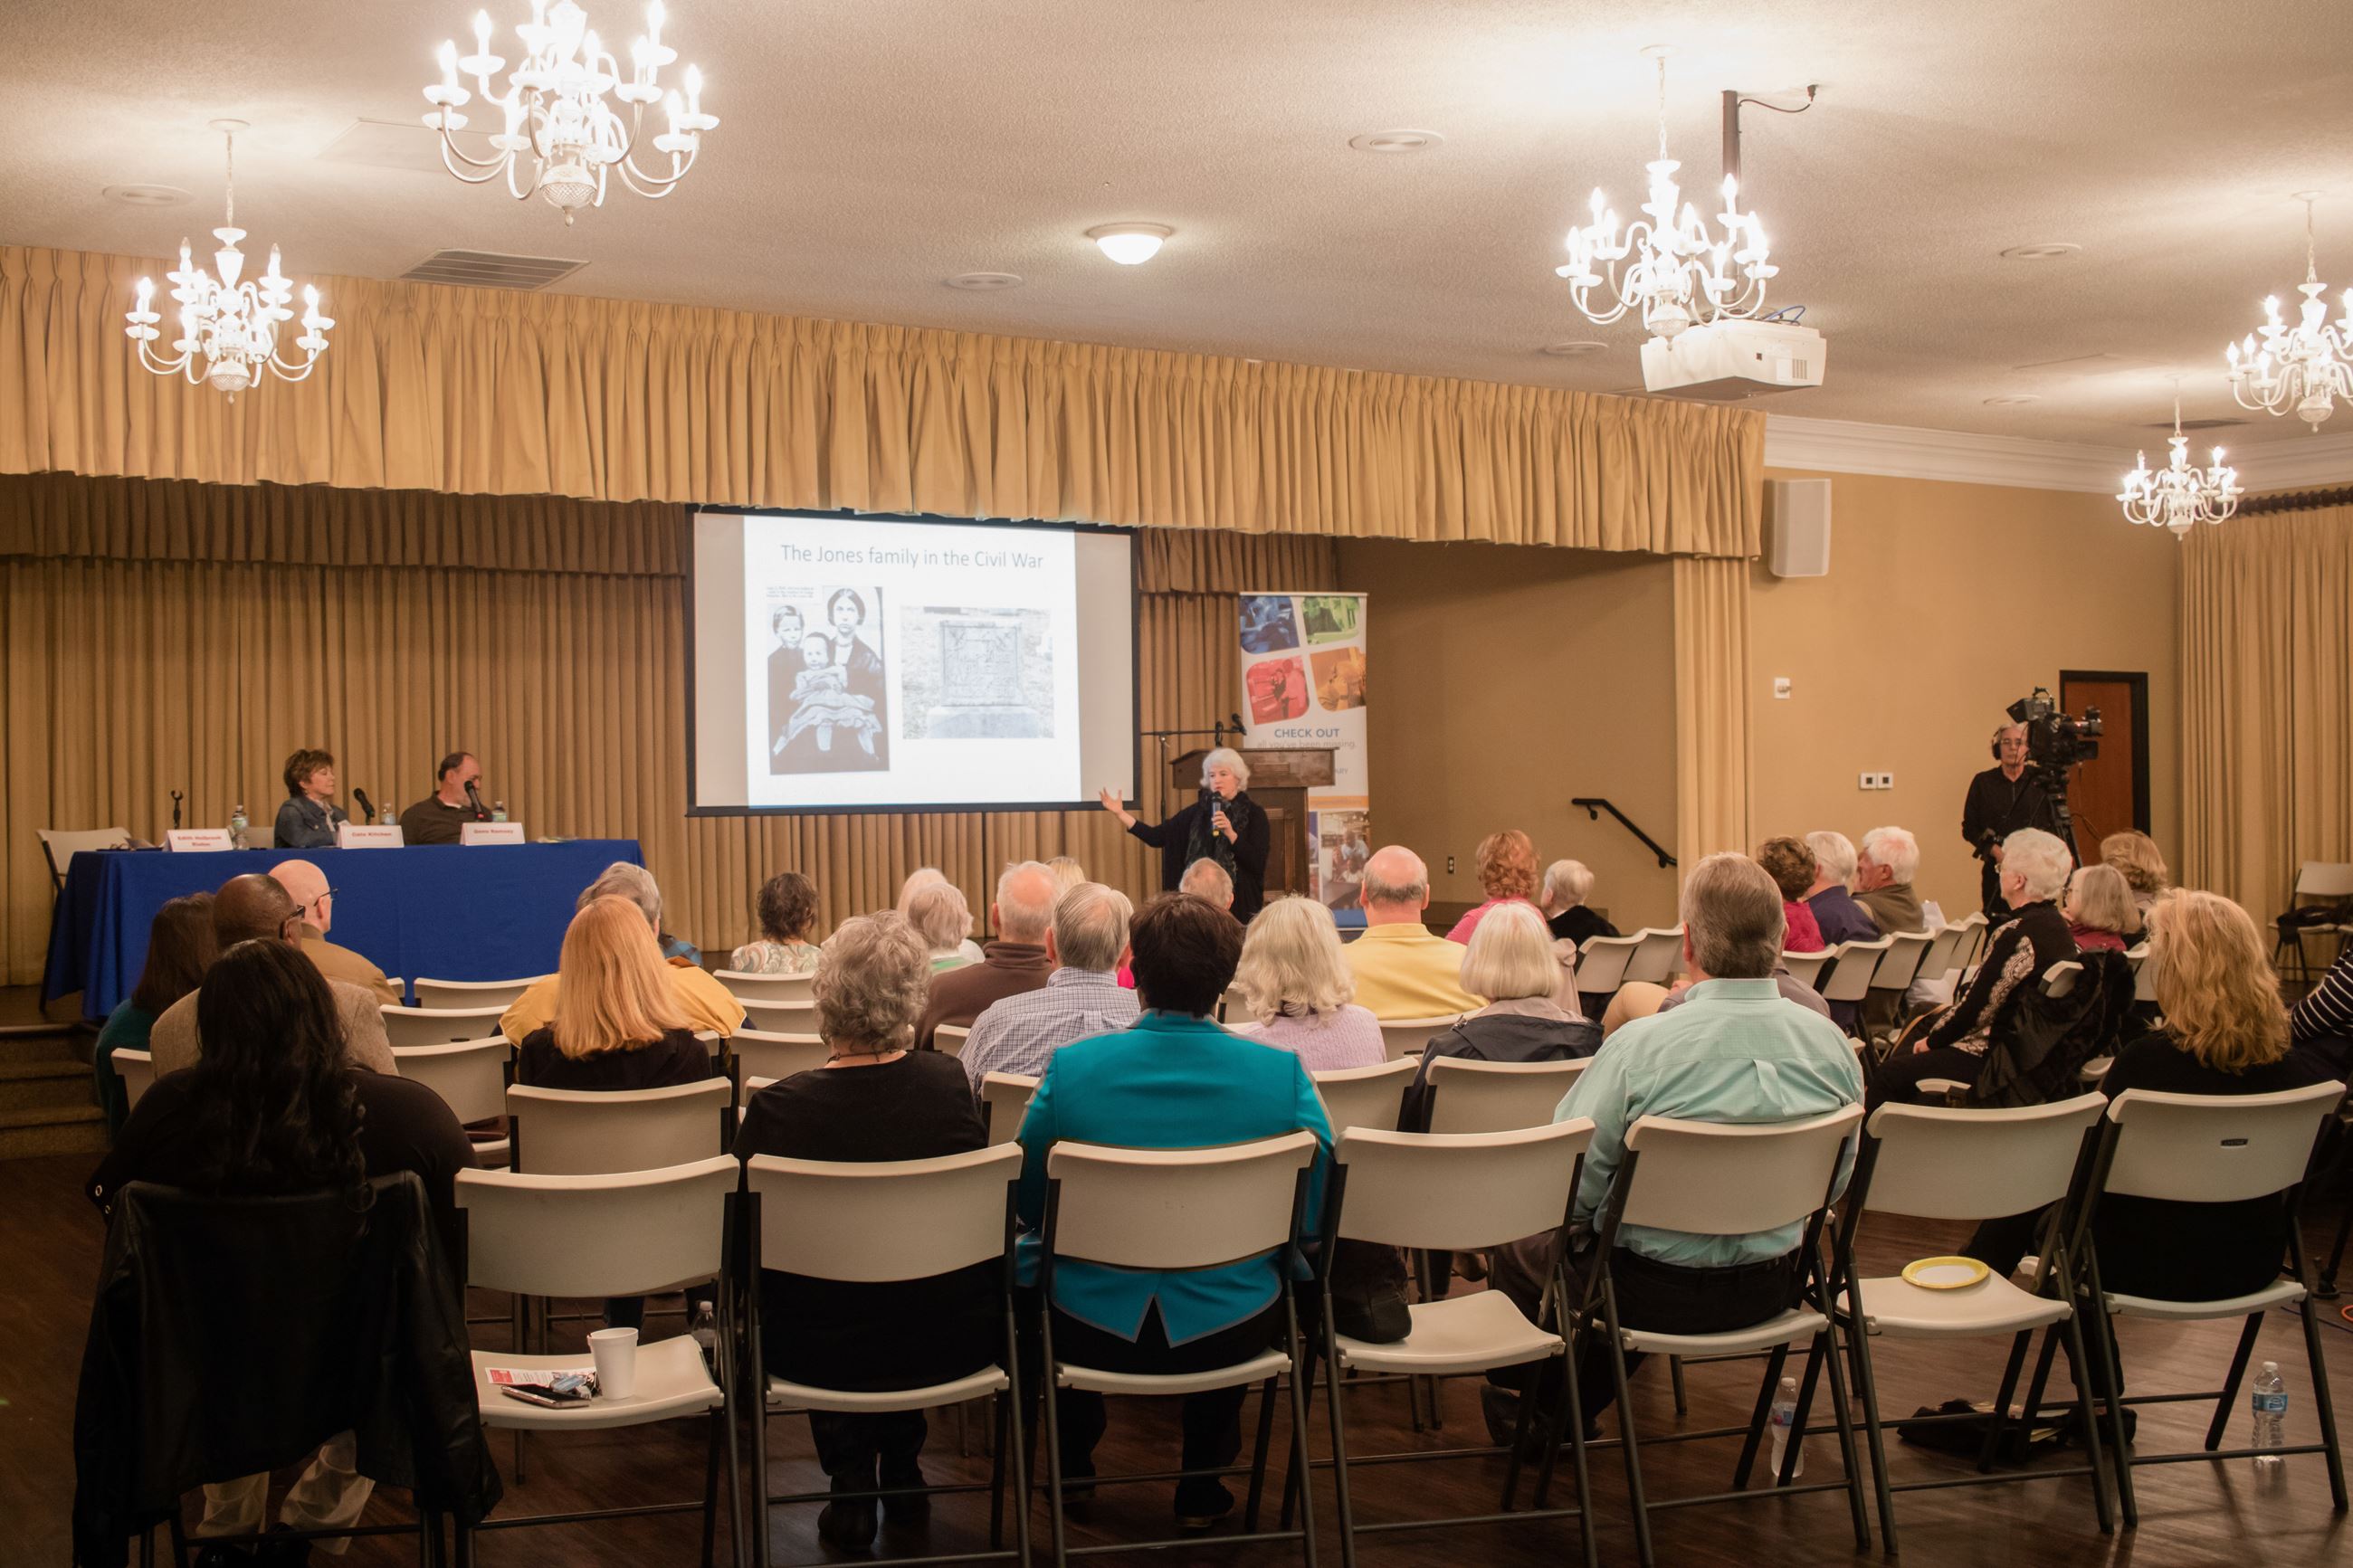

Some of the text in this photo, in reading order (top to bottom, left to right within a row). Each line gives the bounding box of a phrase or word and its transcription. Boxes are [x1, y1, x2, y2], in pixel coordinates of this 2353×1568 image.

[781, 545, 1043, 569] The Jones family in the Civil War
[1274, 728, 1339, 738] CHECK OUT
